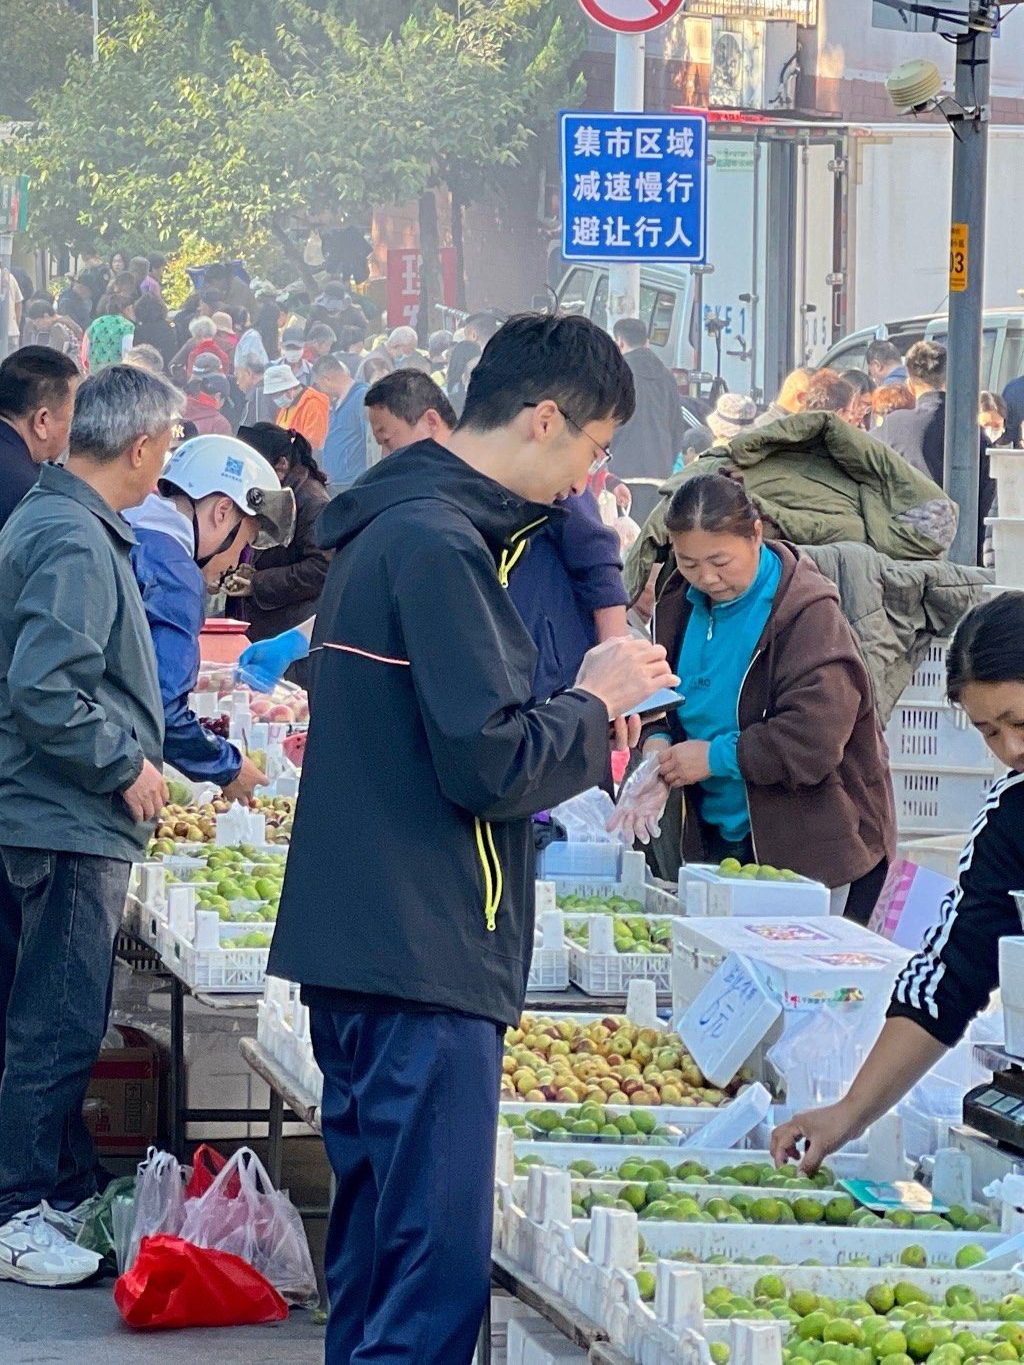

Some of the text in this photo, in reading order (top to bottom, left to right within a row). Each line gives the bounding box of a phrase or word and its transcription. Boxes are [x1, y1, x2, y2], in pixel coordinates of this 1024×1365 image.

[573, 125, 695, 159] 集市区域
[572, 170, 694, 203] 减速慢行
[572, 215, 692, 248] 避让行人
